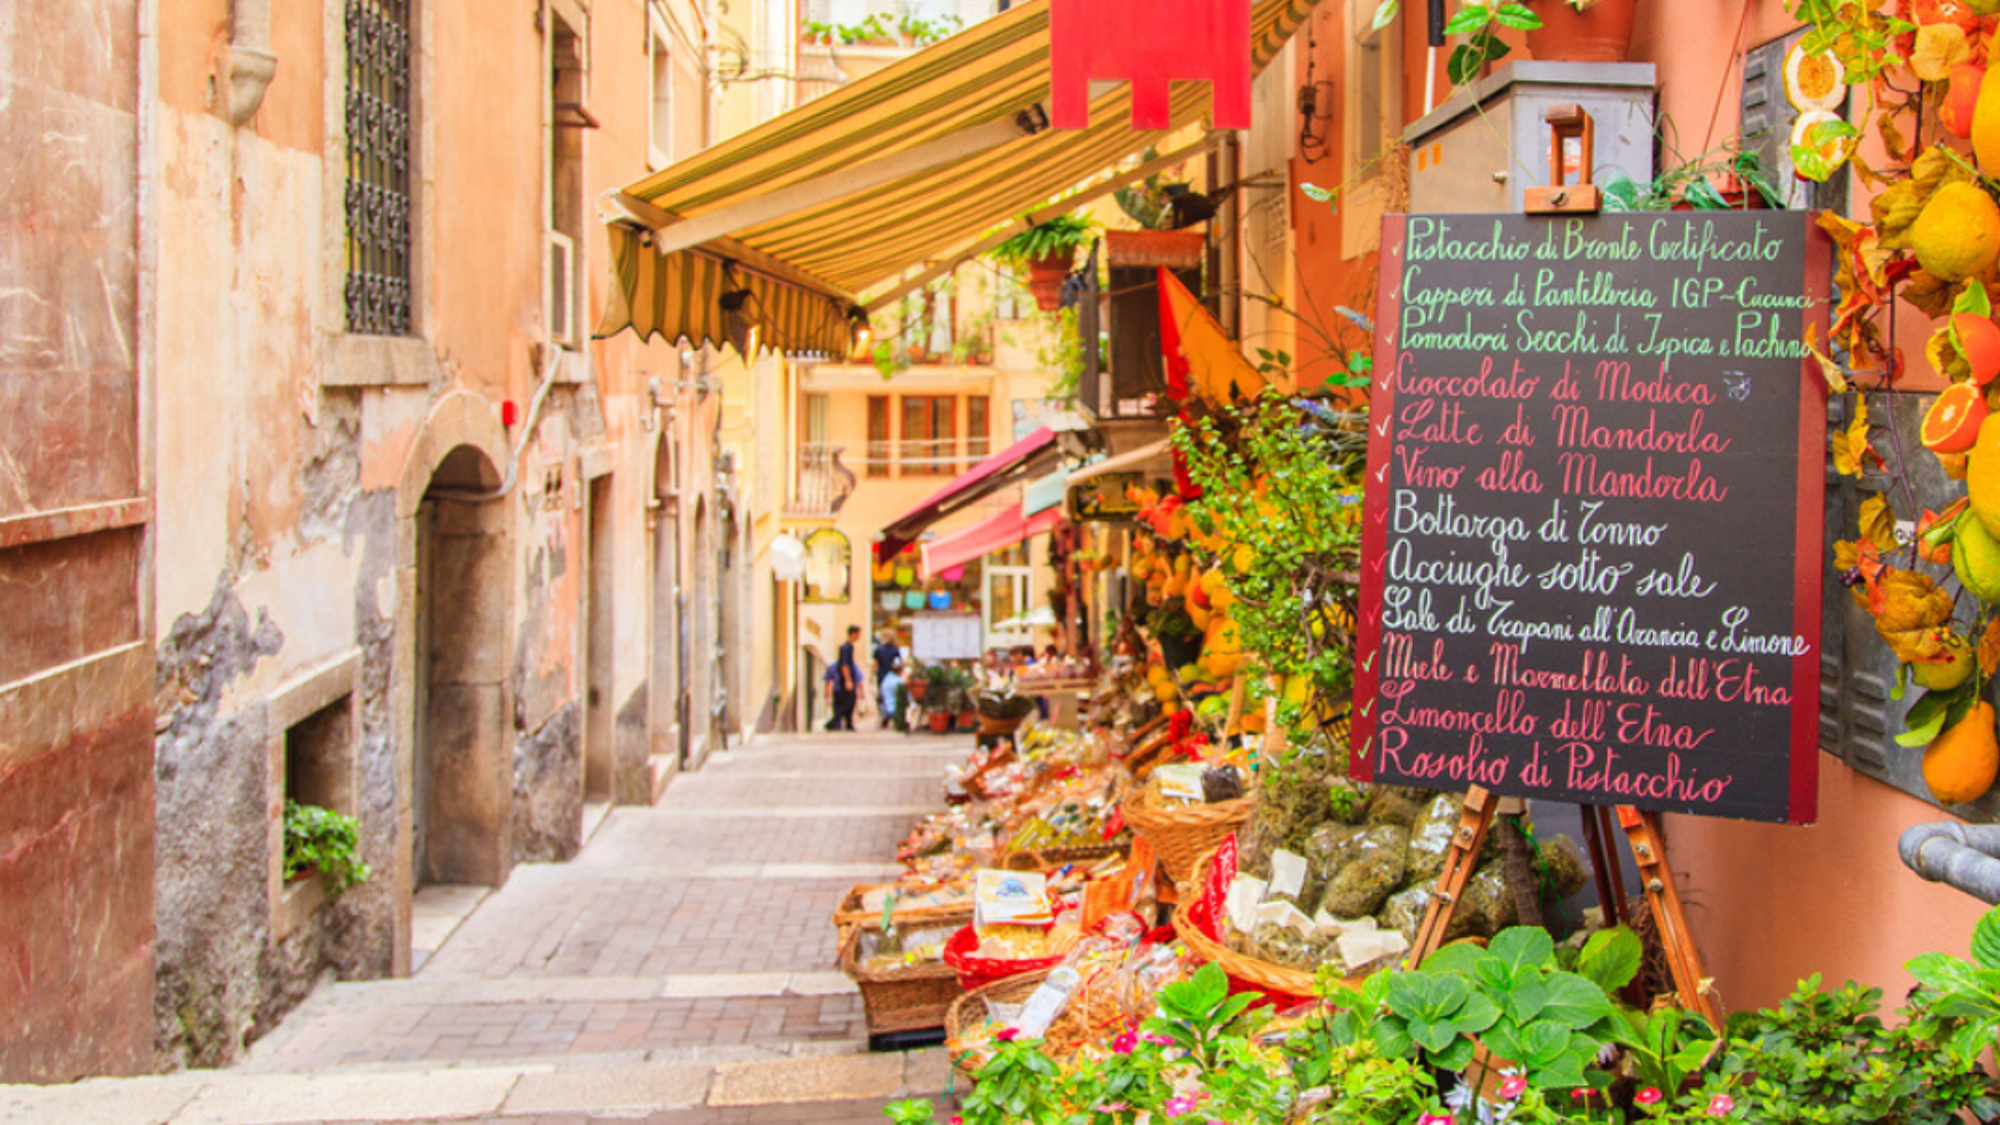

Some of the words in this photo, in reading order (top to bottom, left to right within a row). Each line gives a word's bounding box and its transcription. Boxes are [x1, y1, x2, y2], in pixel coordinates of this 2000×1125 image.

[1406, 217, 1531, 262] Pistacchio
[1533, 219, 1560, 261] di
[1563, 217, 1642, 261] Bronte
[1650, 218, 1784, 273] Certificato
[1402, 264, 1496, 323] Capperi
[1503, 272, 1527, 306] di
[1533, 269, 1658, 307] Pantelleria
[1402, 305, 1509, 351] Pomodori
[1516, 309, 1600, 353] Secchi
[1604, 312, 1629, 354] di
[1637, 312, 1714, 374] Ispica
[1719, 337, 1730, 357] e
[1734, 310, 1812, 359] Pachino
[1396, 351, 1541, 399] Cioccolato
[1549, 359, 1582, 400] di
[1594, 359, 1718, 405] Modica
[1397, 397, 1484, 446] Latte
[1496, 401, 1536, 446] di
[1551, 403, 1732, 454] Mandorla
[1395, 444, 1466, 489] Vino
[1474, 449, 1544, 494] alla
[1557, 452, 1730, 502] Mandorla
[1393, 488, 1532, 556] Bottarga
[1537, 497, 1570, 543] di
[1577, 499, 1669, 547] Tonno
[1388, 536, 1531, 610] Acciughe
[1537, 547, 1635, 596] sotto
[1636, 551, 1719, 598] sale
[1381, 584, 1440, 633] Sale
[1446, 595, 1476, 634] di
[1486, 594, 1575, 655] Trapani
[1706, 628, 1719, 650] e
[1721, 604, 1812, 657] Limone
[1382, 631, 1454, 681] Miele
[1463, 663, 1480, 684] e
[1488, 641, 1650, 696] Marmellata
[1379, 678, 1541, 736] Limoncello
[1378, 725, 1509, 786] Rosolio
[1519, 740, 1553, 788] di
[1555, 741, 1733, 803] Pistacchio
